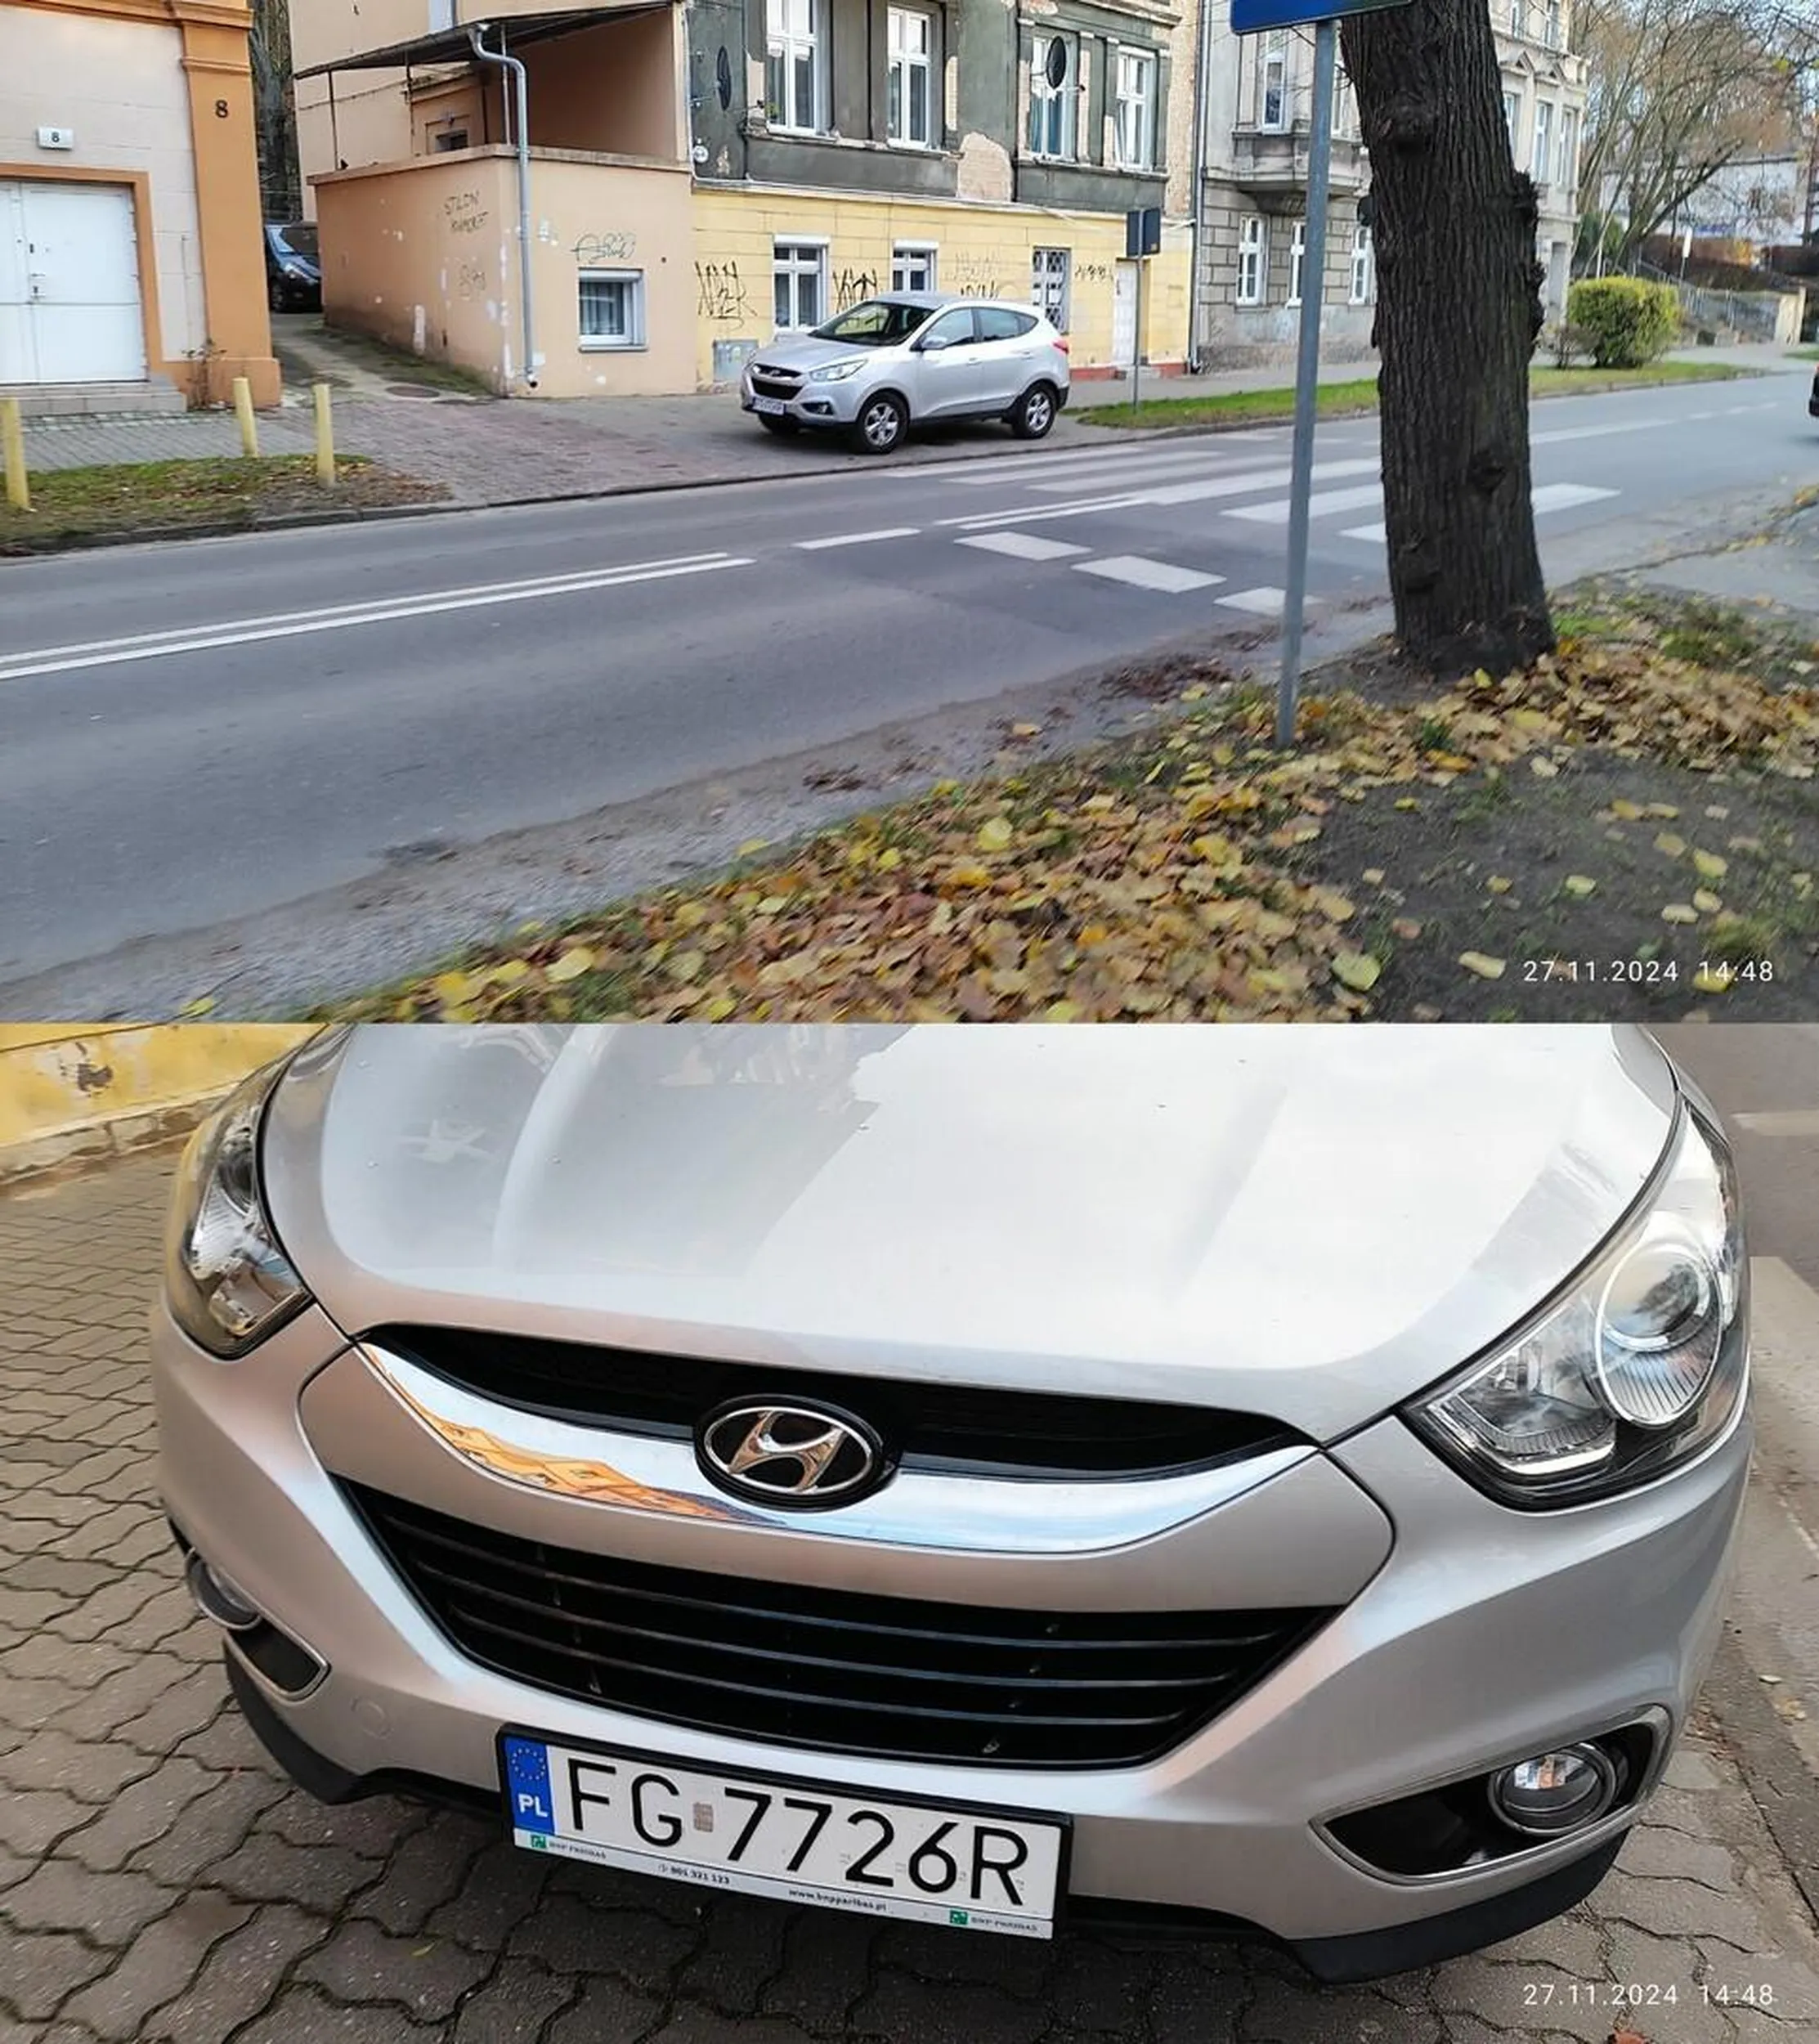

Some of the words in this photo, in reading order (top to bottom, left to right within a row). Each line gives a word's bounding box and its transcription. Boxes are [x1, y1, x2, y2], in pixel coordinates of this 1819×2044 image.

[216, 100, 228, 118] 8
[51, 132, 60, 142] 8
[517, 1793, 548, 1818] PL
[568, 1758, 682, 1847] FG
[724, 1787, 1028, 1906] 7726R
